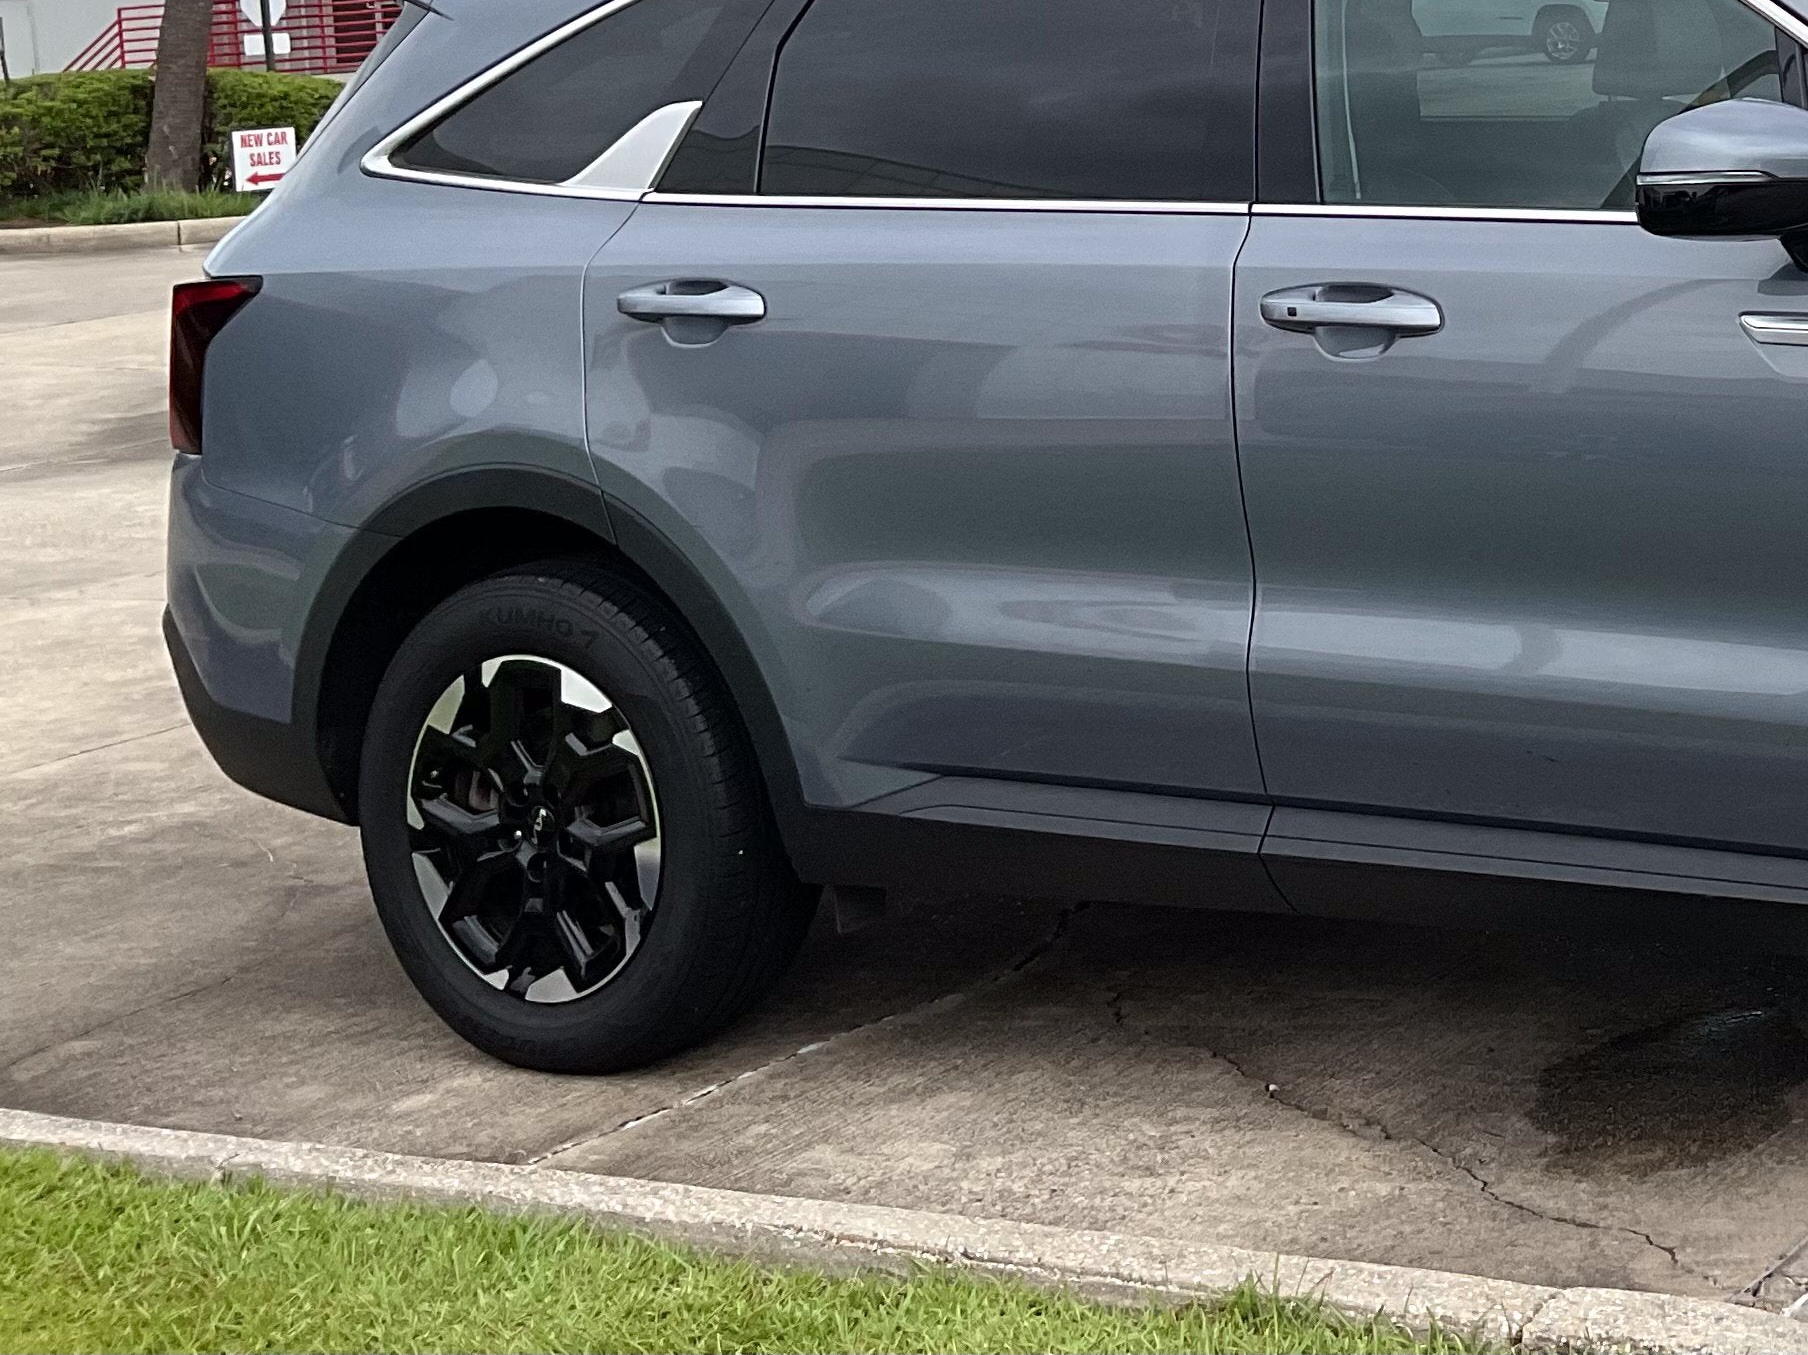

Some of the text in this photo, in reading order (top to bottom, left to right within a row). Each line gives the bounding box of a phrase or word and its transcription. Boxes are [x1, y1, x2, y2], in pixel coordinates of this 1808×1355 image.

[240, 131, 288, 148] NEW CAR
[249, 151, 281, 167] SALES
